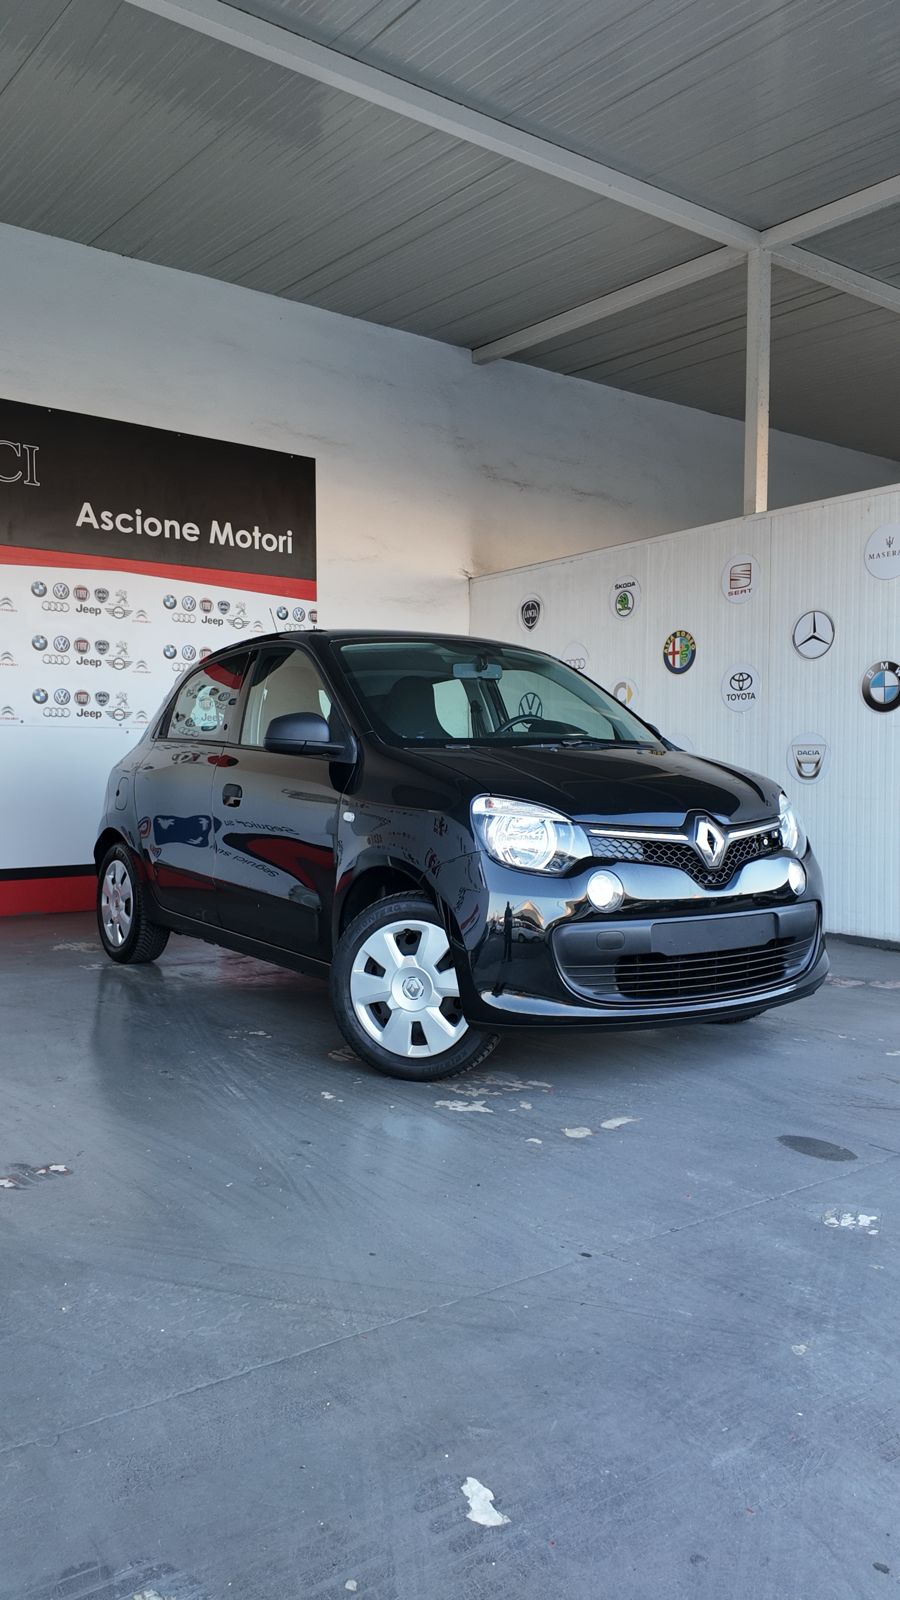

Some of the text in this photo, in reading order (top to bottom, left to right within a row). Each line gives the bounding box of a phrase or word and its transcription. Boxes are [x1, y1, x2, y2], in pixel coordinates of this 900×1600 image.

[75, 502, 293, 554] Ascione Motori
[728, 588, 753, 597] SEAT
[76, 604, 101, 616] Jeep
[201, 616, 224, 626] Jeep
[76, 656, 102, 668] Jeep
[726, 692, 756, 702] TOYOTA
[77, 708, 102, 719] Jeep
